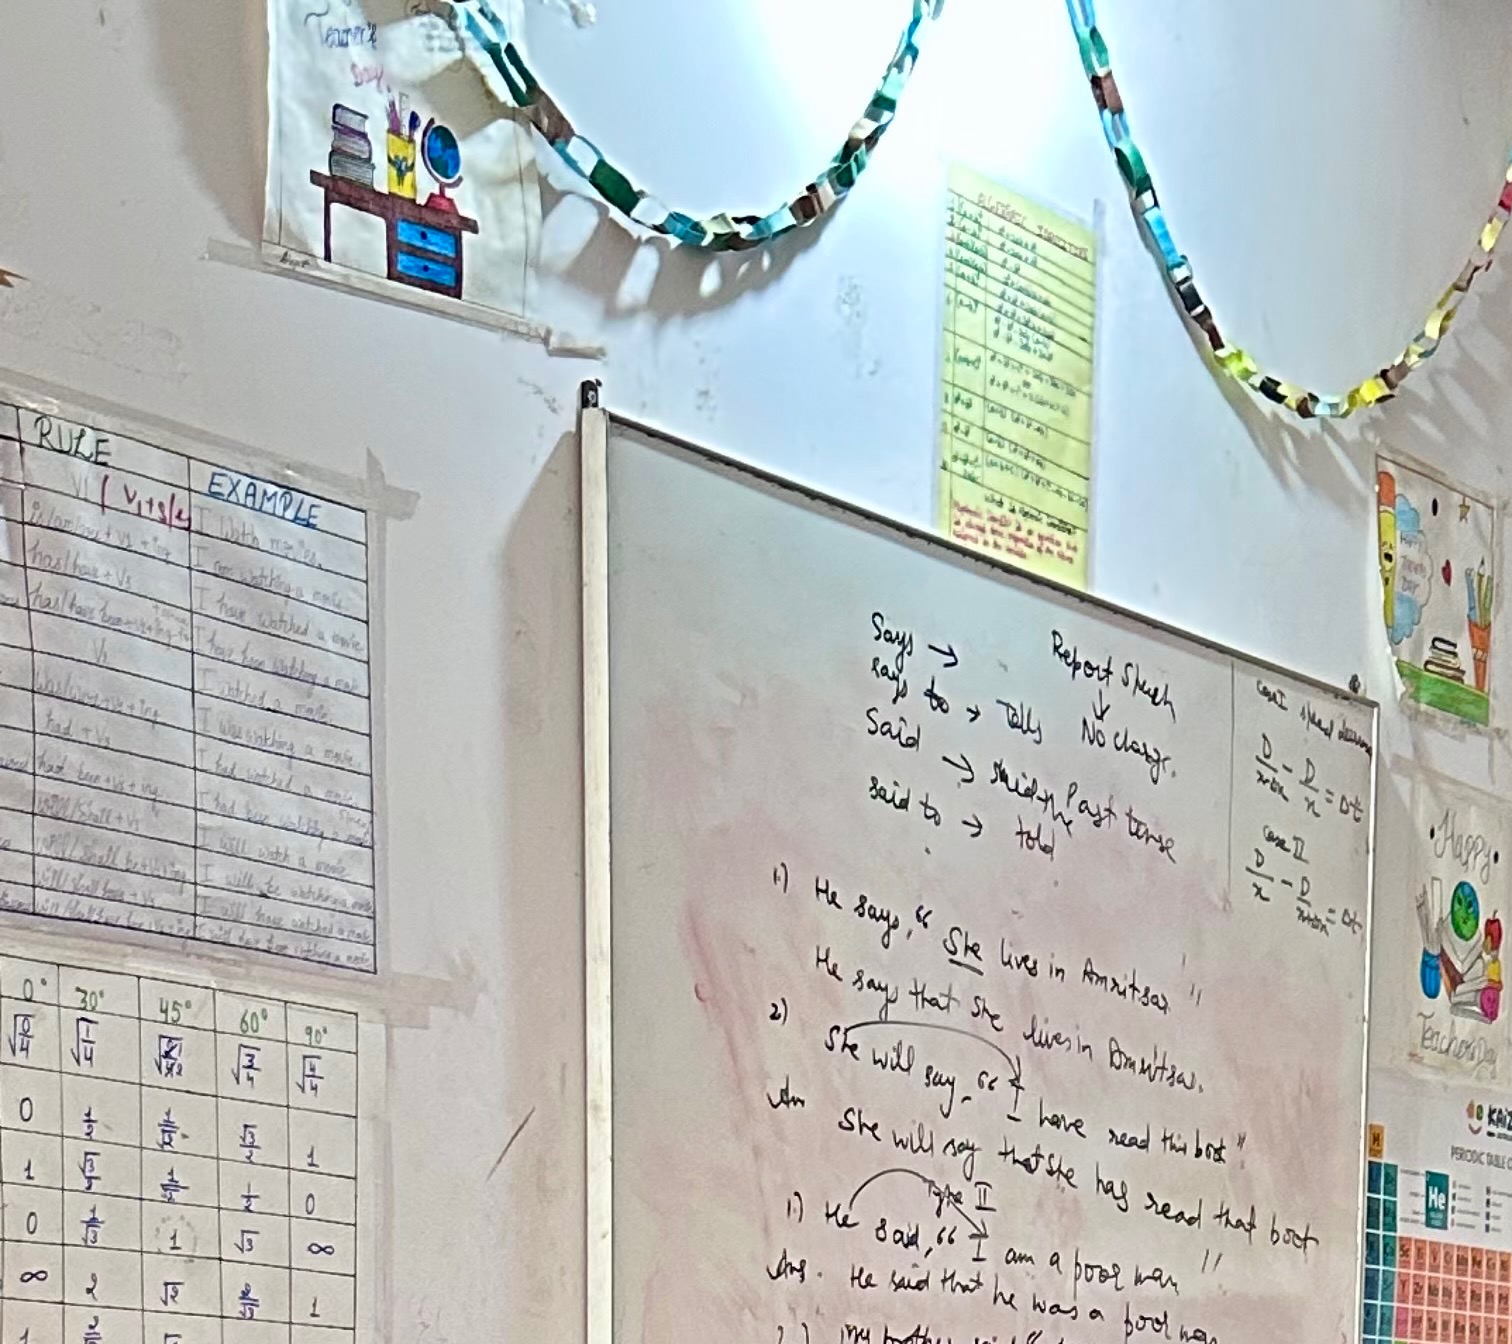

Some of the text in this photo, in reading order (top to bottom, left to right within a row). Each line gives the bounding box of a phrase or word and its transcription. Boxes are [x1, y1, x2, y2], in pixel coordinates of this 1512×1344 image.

[34, 413, 111, 466] RULE
[206, 471, 321, 529] EXAMPLE
[1051, 629, 1114, 688] Report
[923, 675, 950, 715] to
[866, 706, 921, 753] Said
[1081, 715, 1106, 749] No
[919, 791, 943, 827] to
[1015, 814, 1056, 863] told
[1434, 808, 1495, 885] Happy
[814, 875, 844, 910] He
[942, 926, 984, 963] She
[1000, 936, 1039, 978] lives
[1049, 953, 1066, 983] in
[158, 996, 192, 1025] 45°
[239, 1007, 269, 1034] 60°
[815, 944, 844, 982] He
[908, 977, 962, 1014] that
[1022, 1013, 1073, 1052] lives
[1077, 1022, 1094, 1063] in
[768, 997, 789, 1027] 2)
[824, 1024, 861, 1062] She
[871, 1039, 916, 1077] will
[1038, 1096, 1088, 1140] have
[1108, 1122, 1151, 1154] read
[19, 1096, 34, 1123] 0
[838, 1106, 882, 1143] She
[891, 1121, 934, 1158] will
[942, 1137, 983, 1182] say
[998, 1135, 1045, 1175] that
[1095, 1160, 1130, 1213] has
[1144, 1191, 1202, 1230] read
[1213, 1200, 1257, 1246] that
[1450, 1144, 1485, 1166] PERIODIC
[1486, 1151, 1506, 1170] TABLE
[305, 1192, 316, 1216] 0
[1428, 1185, 1447, 1210] He
[26, 1211, 39, 1235] 0
[825, 1200, 860, 1229] He
[1004, 1248, 1036, 1267] am
[1049, 1251, 1064, 1276] a
[1073, 1248, 1125, 1302] poor
[1133, 1264, 1181, 1297] man
[850, 1263, 879, 1290] He
[890, 1264, 931, 1293] said
[941, 1266, 985, 1294] that
[992, 1272, 1020, 1310] he
[1032, 1291, 1079, 1320] was
[1088, 1308, 1105, 1323] a
